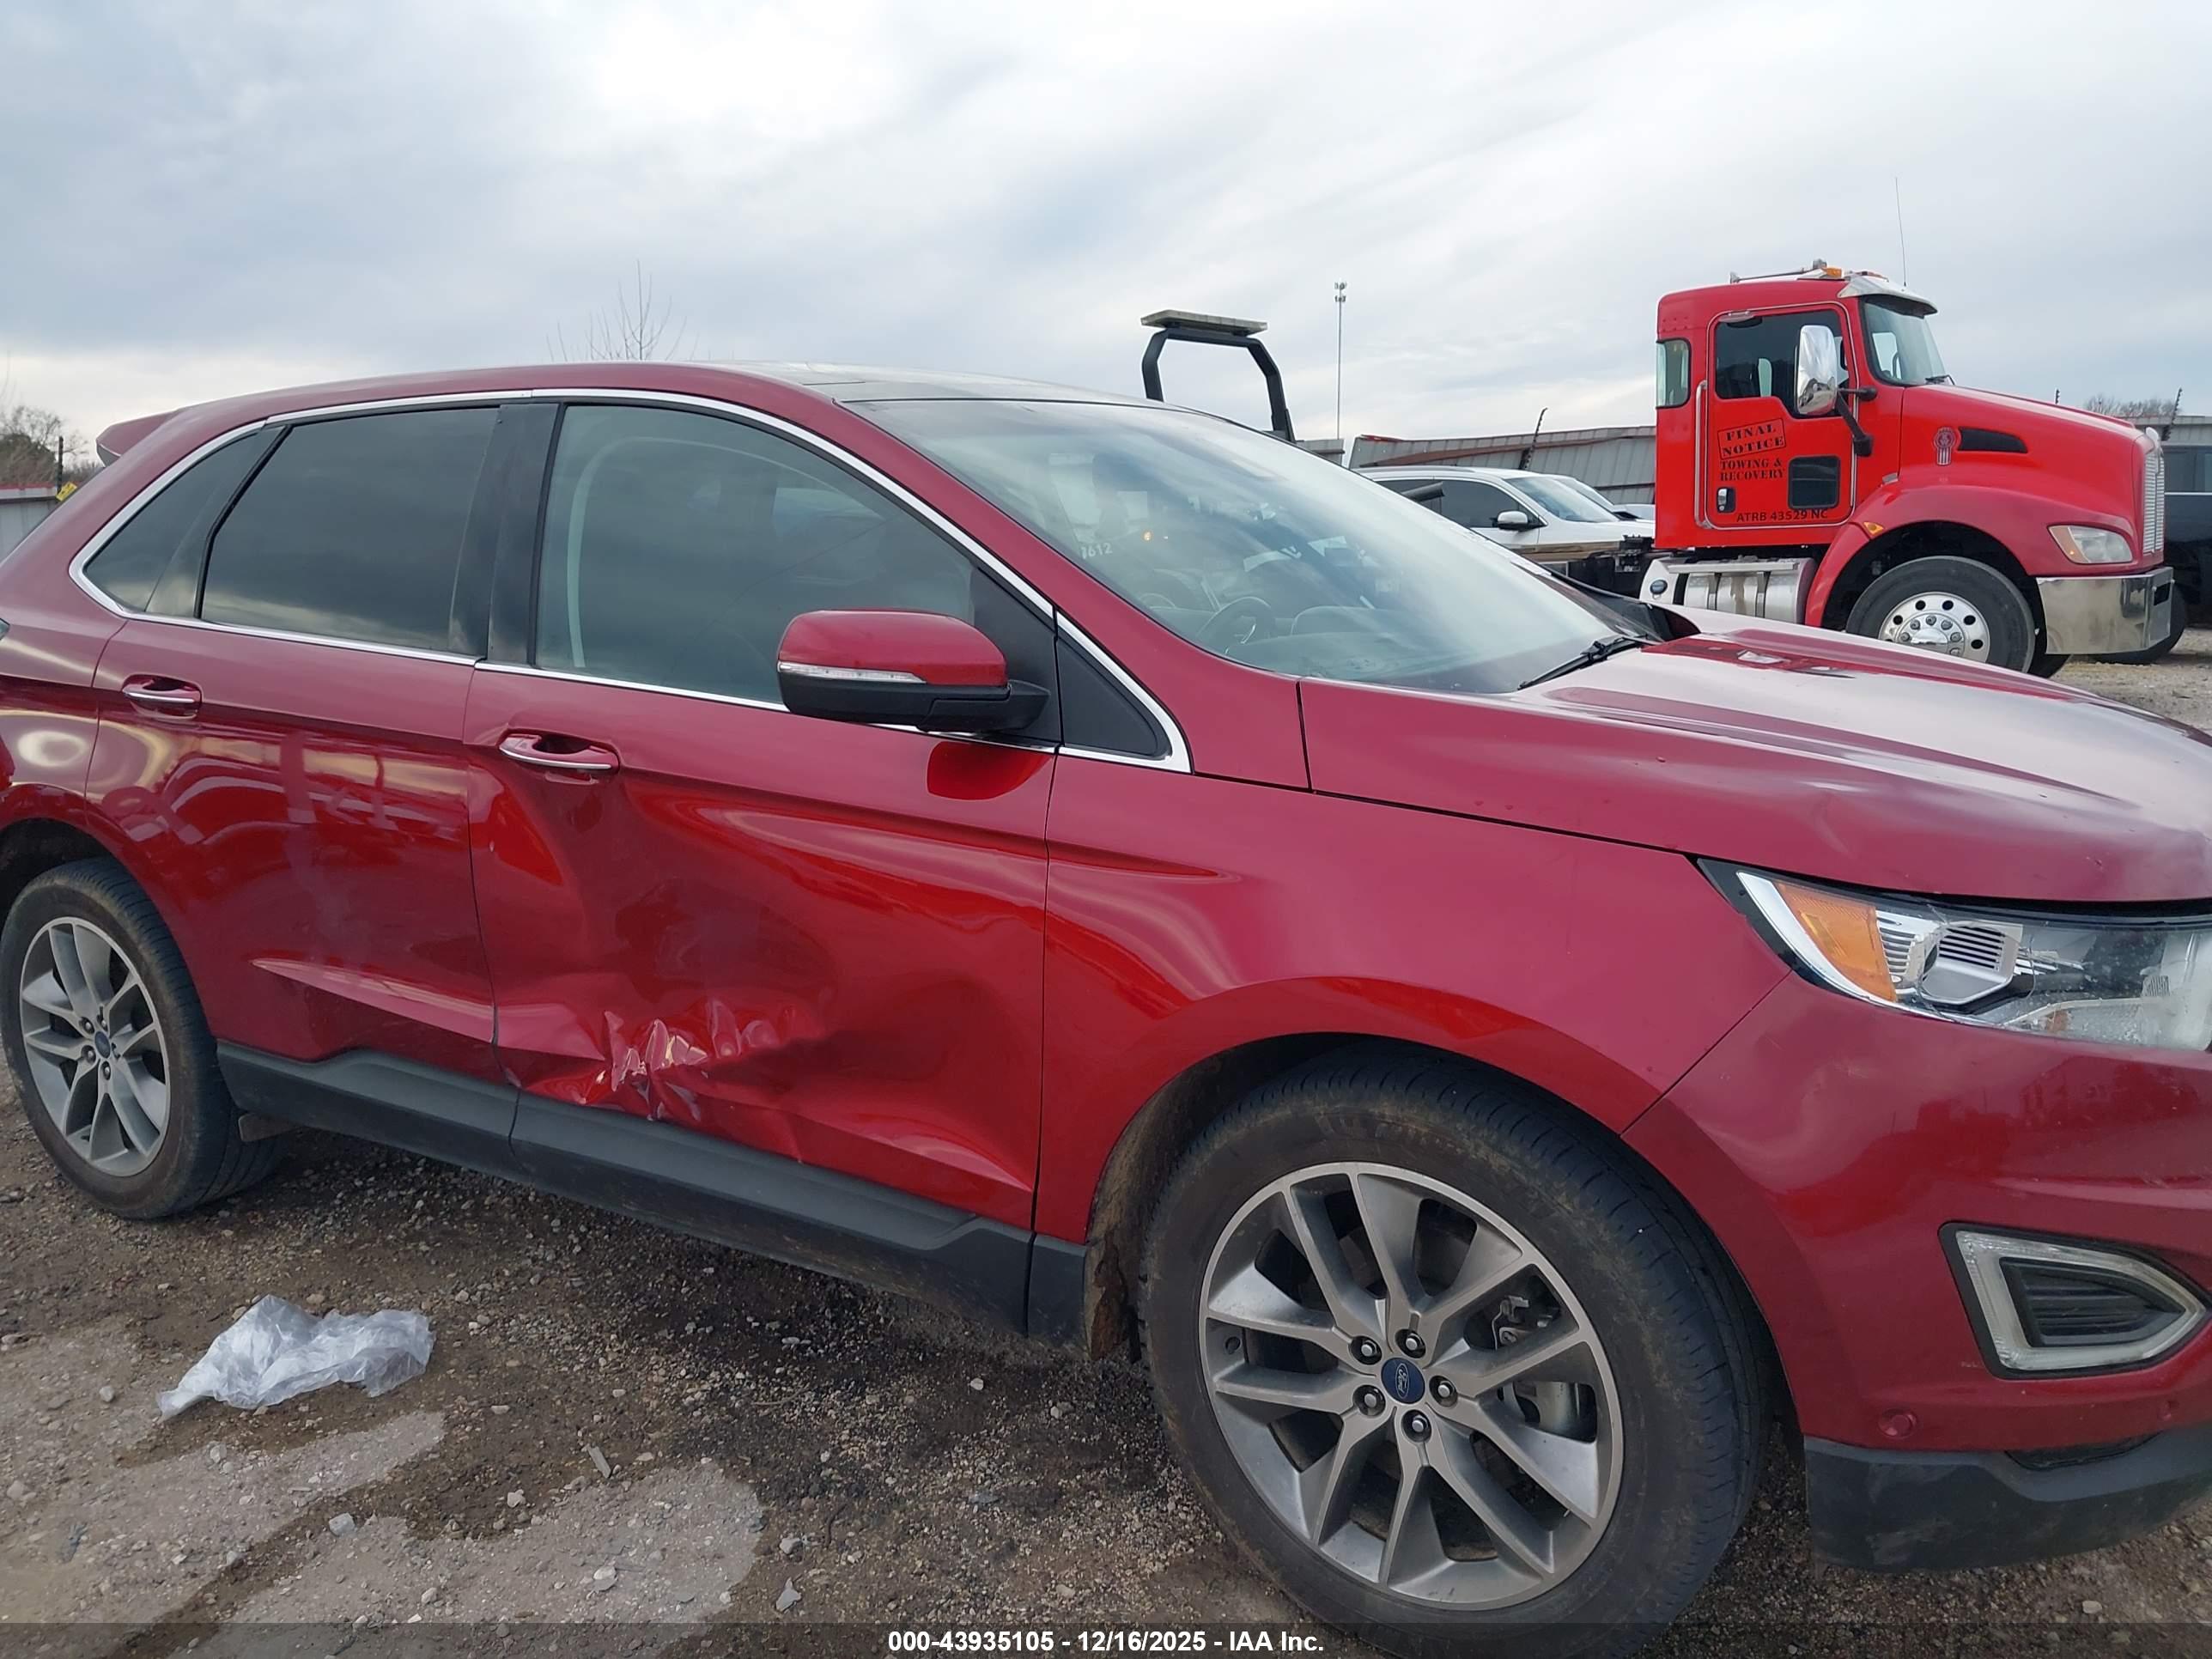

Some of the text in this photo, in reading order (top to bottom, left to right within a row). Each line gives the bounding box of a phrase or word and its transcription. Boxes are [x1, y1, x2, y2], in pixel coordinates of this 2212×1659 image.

[1726, 424, 1776, 441] FINAL
[1723, 436, 1784, 457] NOTICE
[1720, 458, 1782, 470] TOWING &
[1720, 468, 1784, 481] RECOVERY
[1736, 509, 1828, 522] ATRB 43529 NC
